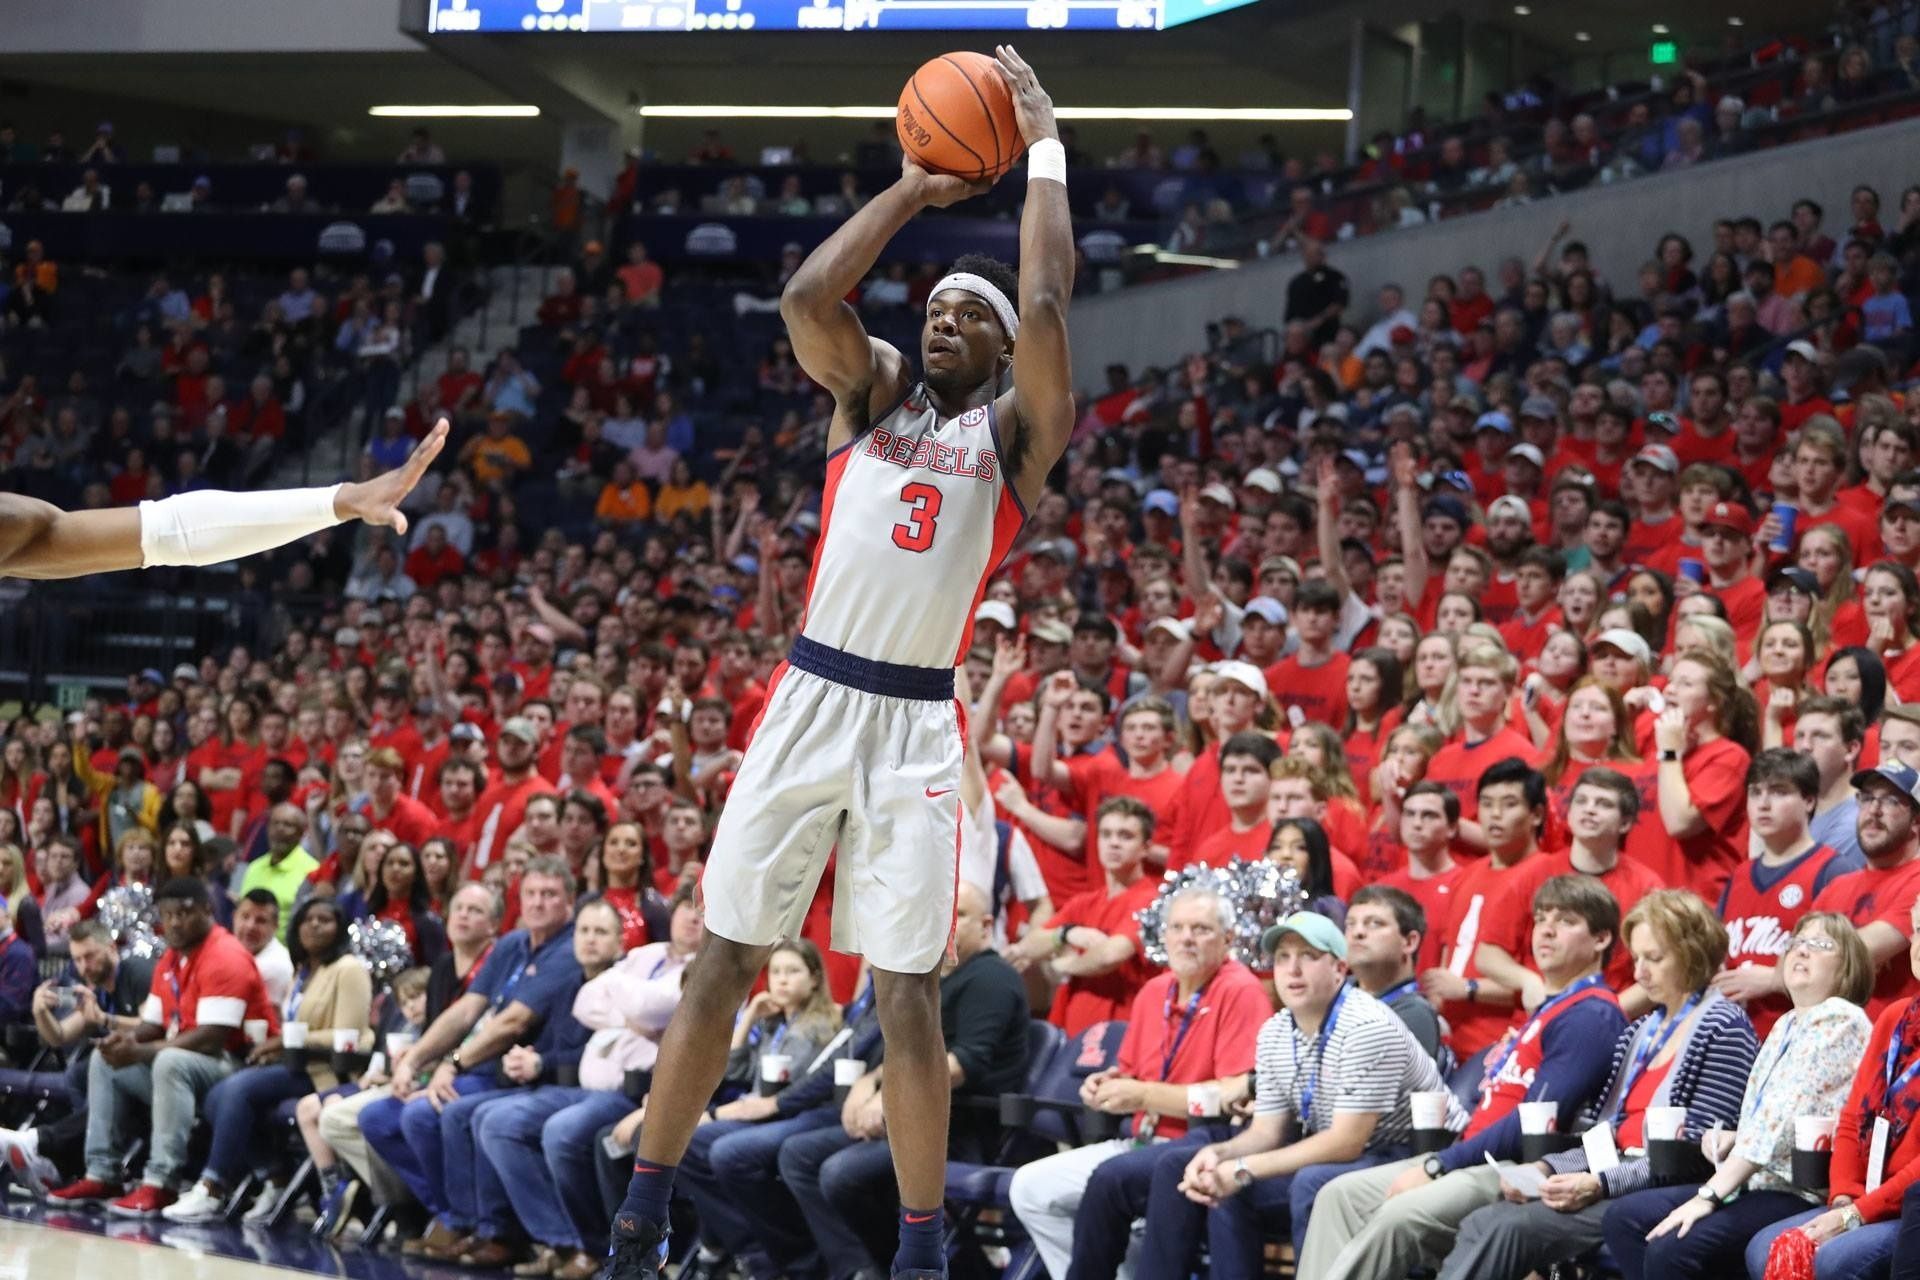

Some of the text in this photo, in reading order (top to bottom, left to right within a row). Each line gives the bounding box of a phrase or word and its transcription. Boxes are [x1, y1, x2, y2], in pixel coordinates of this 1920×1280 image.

[961, 408, 984, 425] SEC
[864, 427, 998, 482] REBELS
[891, 481, 943, 553] 3
